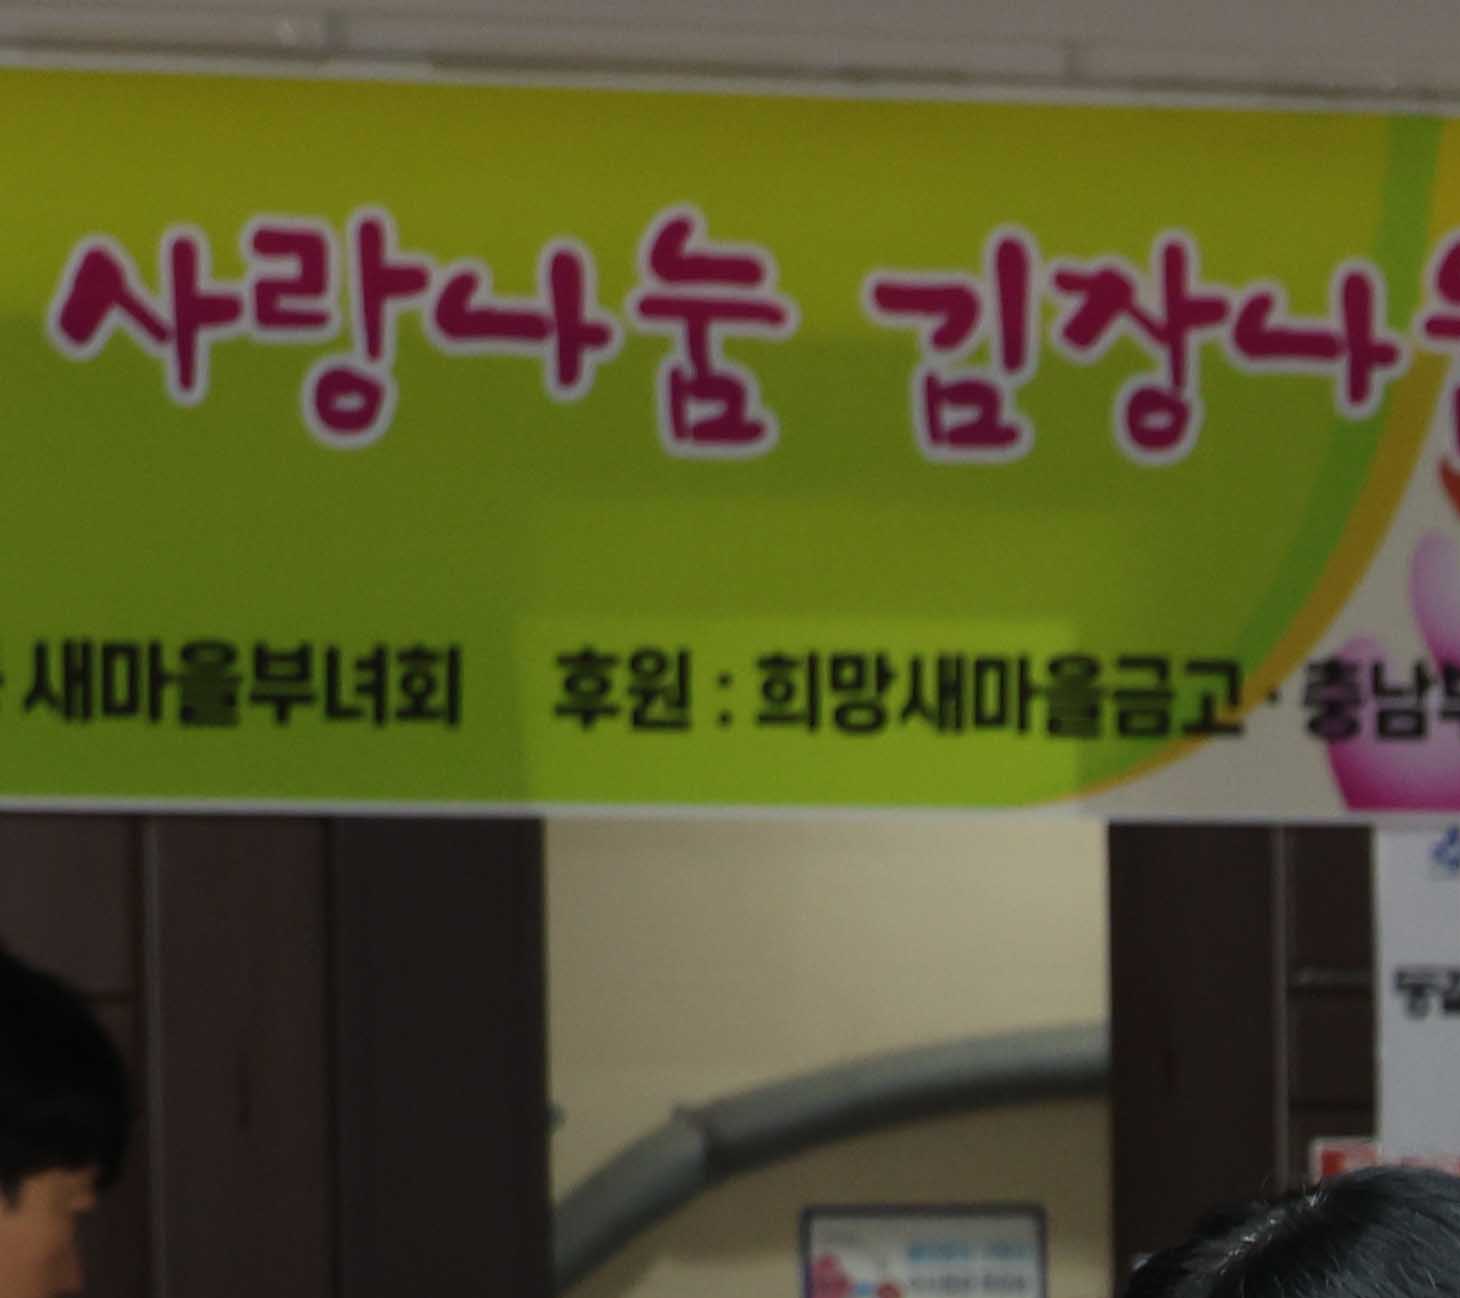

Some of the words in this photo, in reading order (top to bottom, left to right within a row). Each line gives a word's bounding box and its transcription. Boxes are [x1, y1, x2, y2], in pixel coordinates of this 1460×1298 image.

[58, 214, 788, 444] 사랑나눔
[22, 638, 464, 729] 새마을부녀회
[554, 645, 692, 732] 후원
[756, 652, 1246, 739] 희망새마을금고
